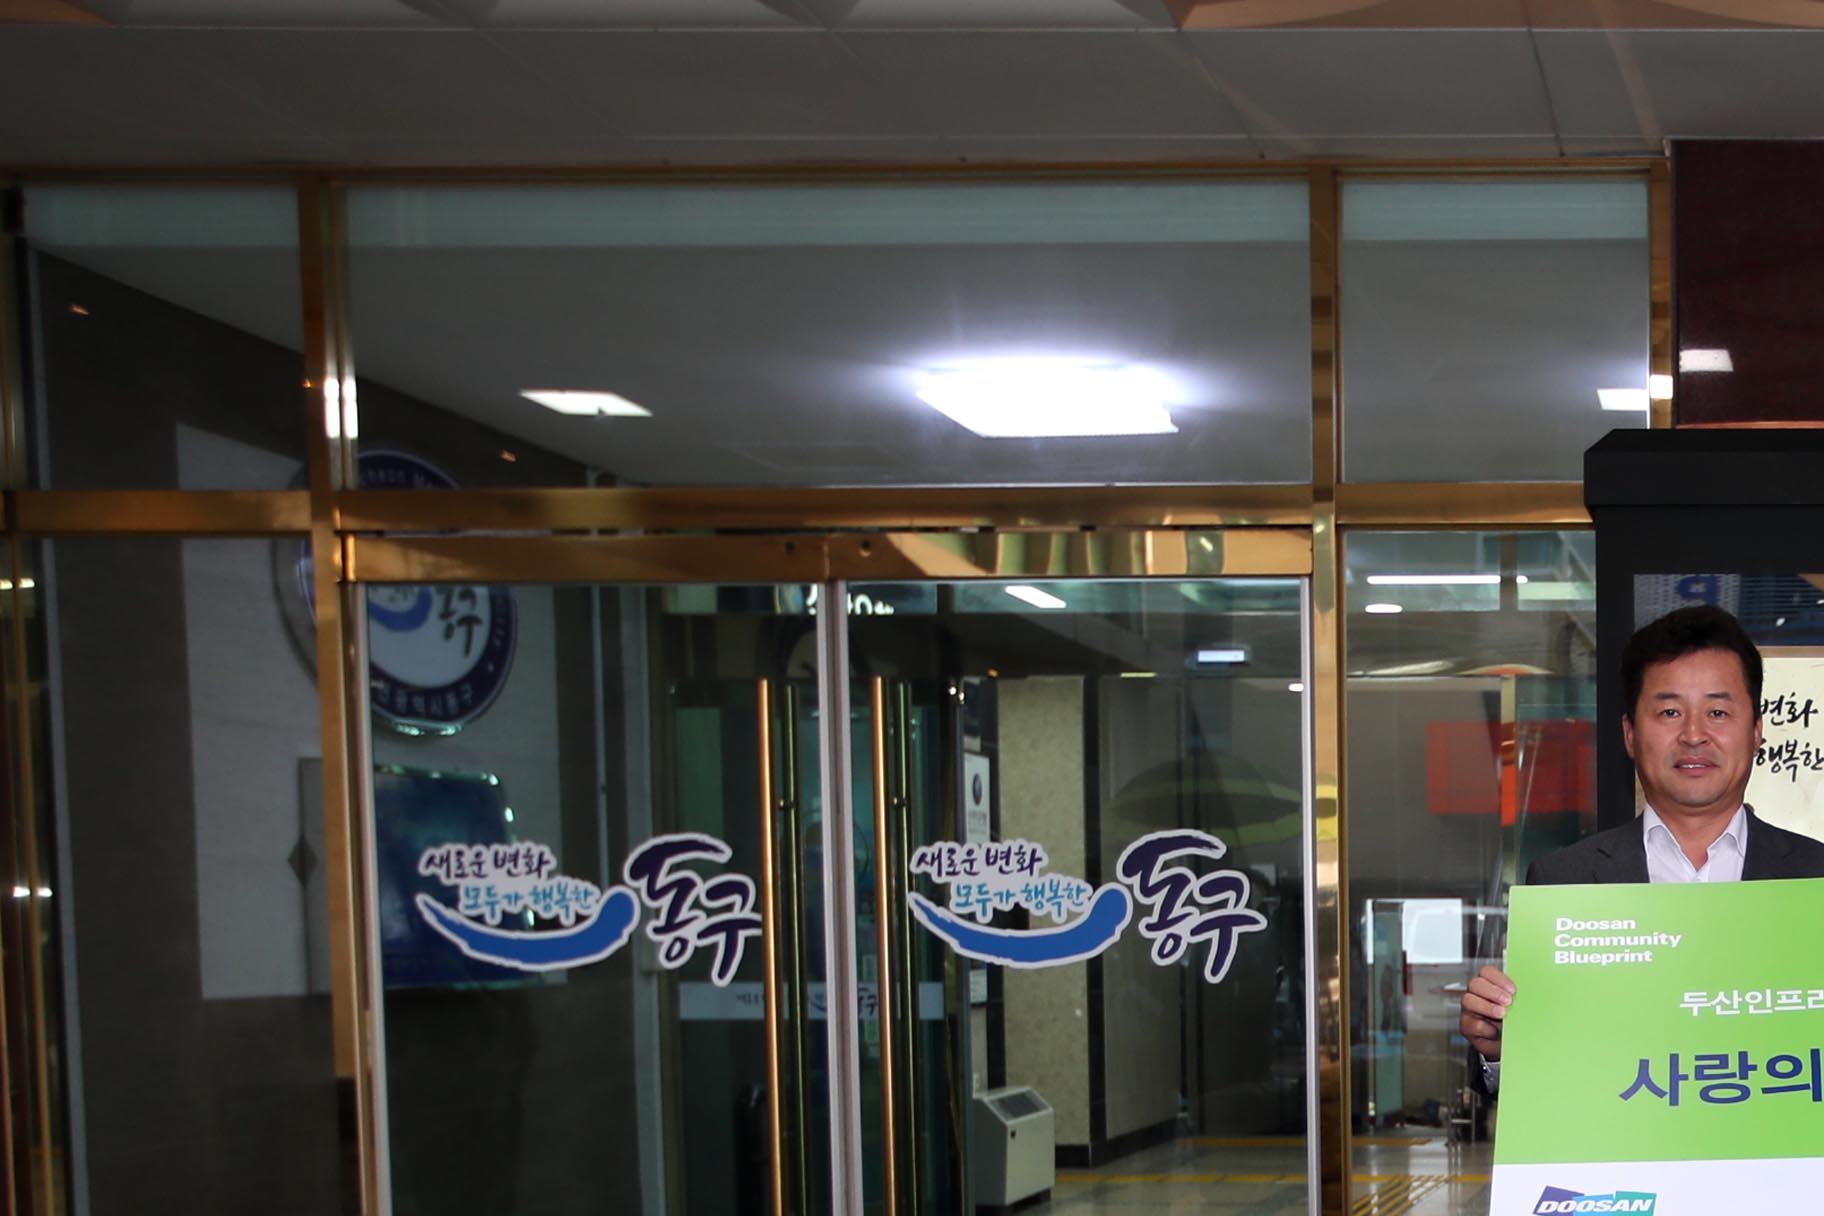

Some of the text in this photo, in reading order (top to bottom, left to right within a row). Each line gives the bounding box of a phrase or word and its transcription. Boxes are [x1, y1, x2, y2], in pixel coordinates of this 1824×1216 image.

[1760, 692, 1819, 728] 변화
[425, 849, 551, 882] 새로운 변화
[916, 843, 1041, 877] 새로운 변화
[461, 884, 594, 924] 모두가 행복한
[628, 836, 761, 980] 동구
[954, 881, 1086, 918] 모두가 행복한
[1122, 835, 1263, 976] 동구
[1555, 932, 1681, 949] Community
[1556, 917, 1636, 930] Doosan
[1555, 949, 1653, 966] Blueprint
[1619, 1046, 1824, 1108] 사랑의
[1537, 1196, 1653, 1216] DOOSAN
